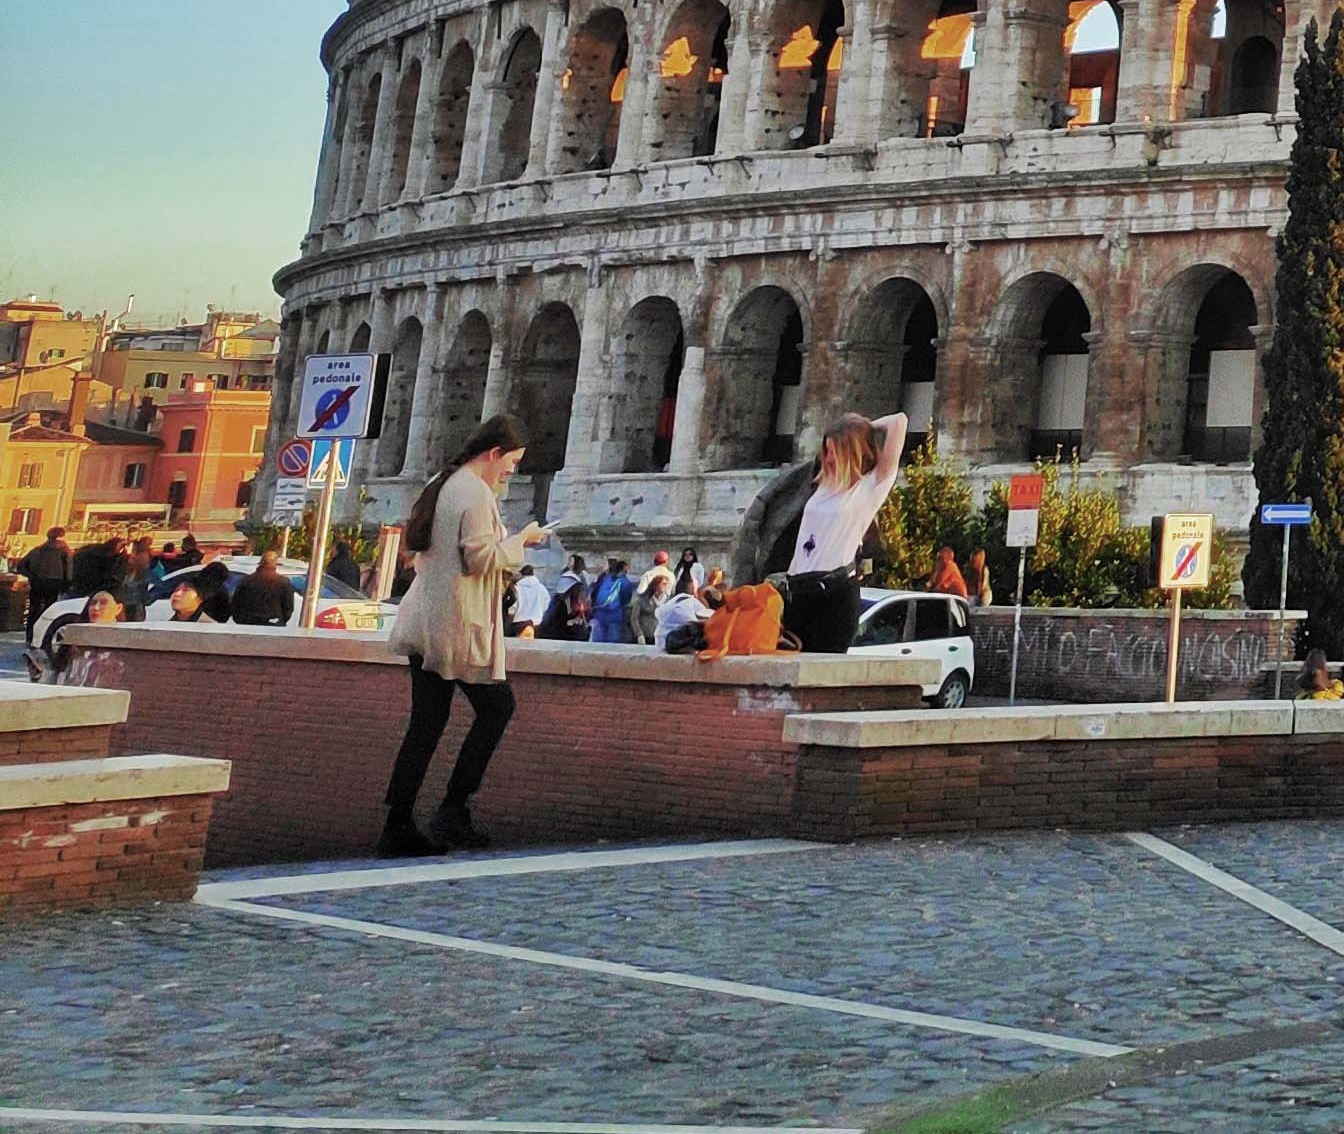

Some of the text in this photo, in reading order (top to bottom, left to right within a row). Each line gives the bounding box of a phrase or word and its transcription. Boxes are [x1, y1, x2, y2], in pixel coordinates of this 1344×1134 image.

[327, 361, 351, 370] area
[312, 372, 362, 385] pedonale
[1013, 484, 1041, 496] TAXI
